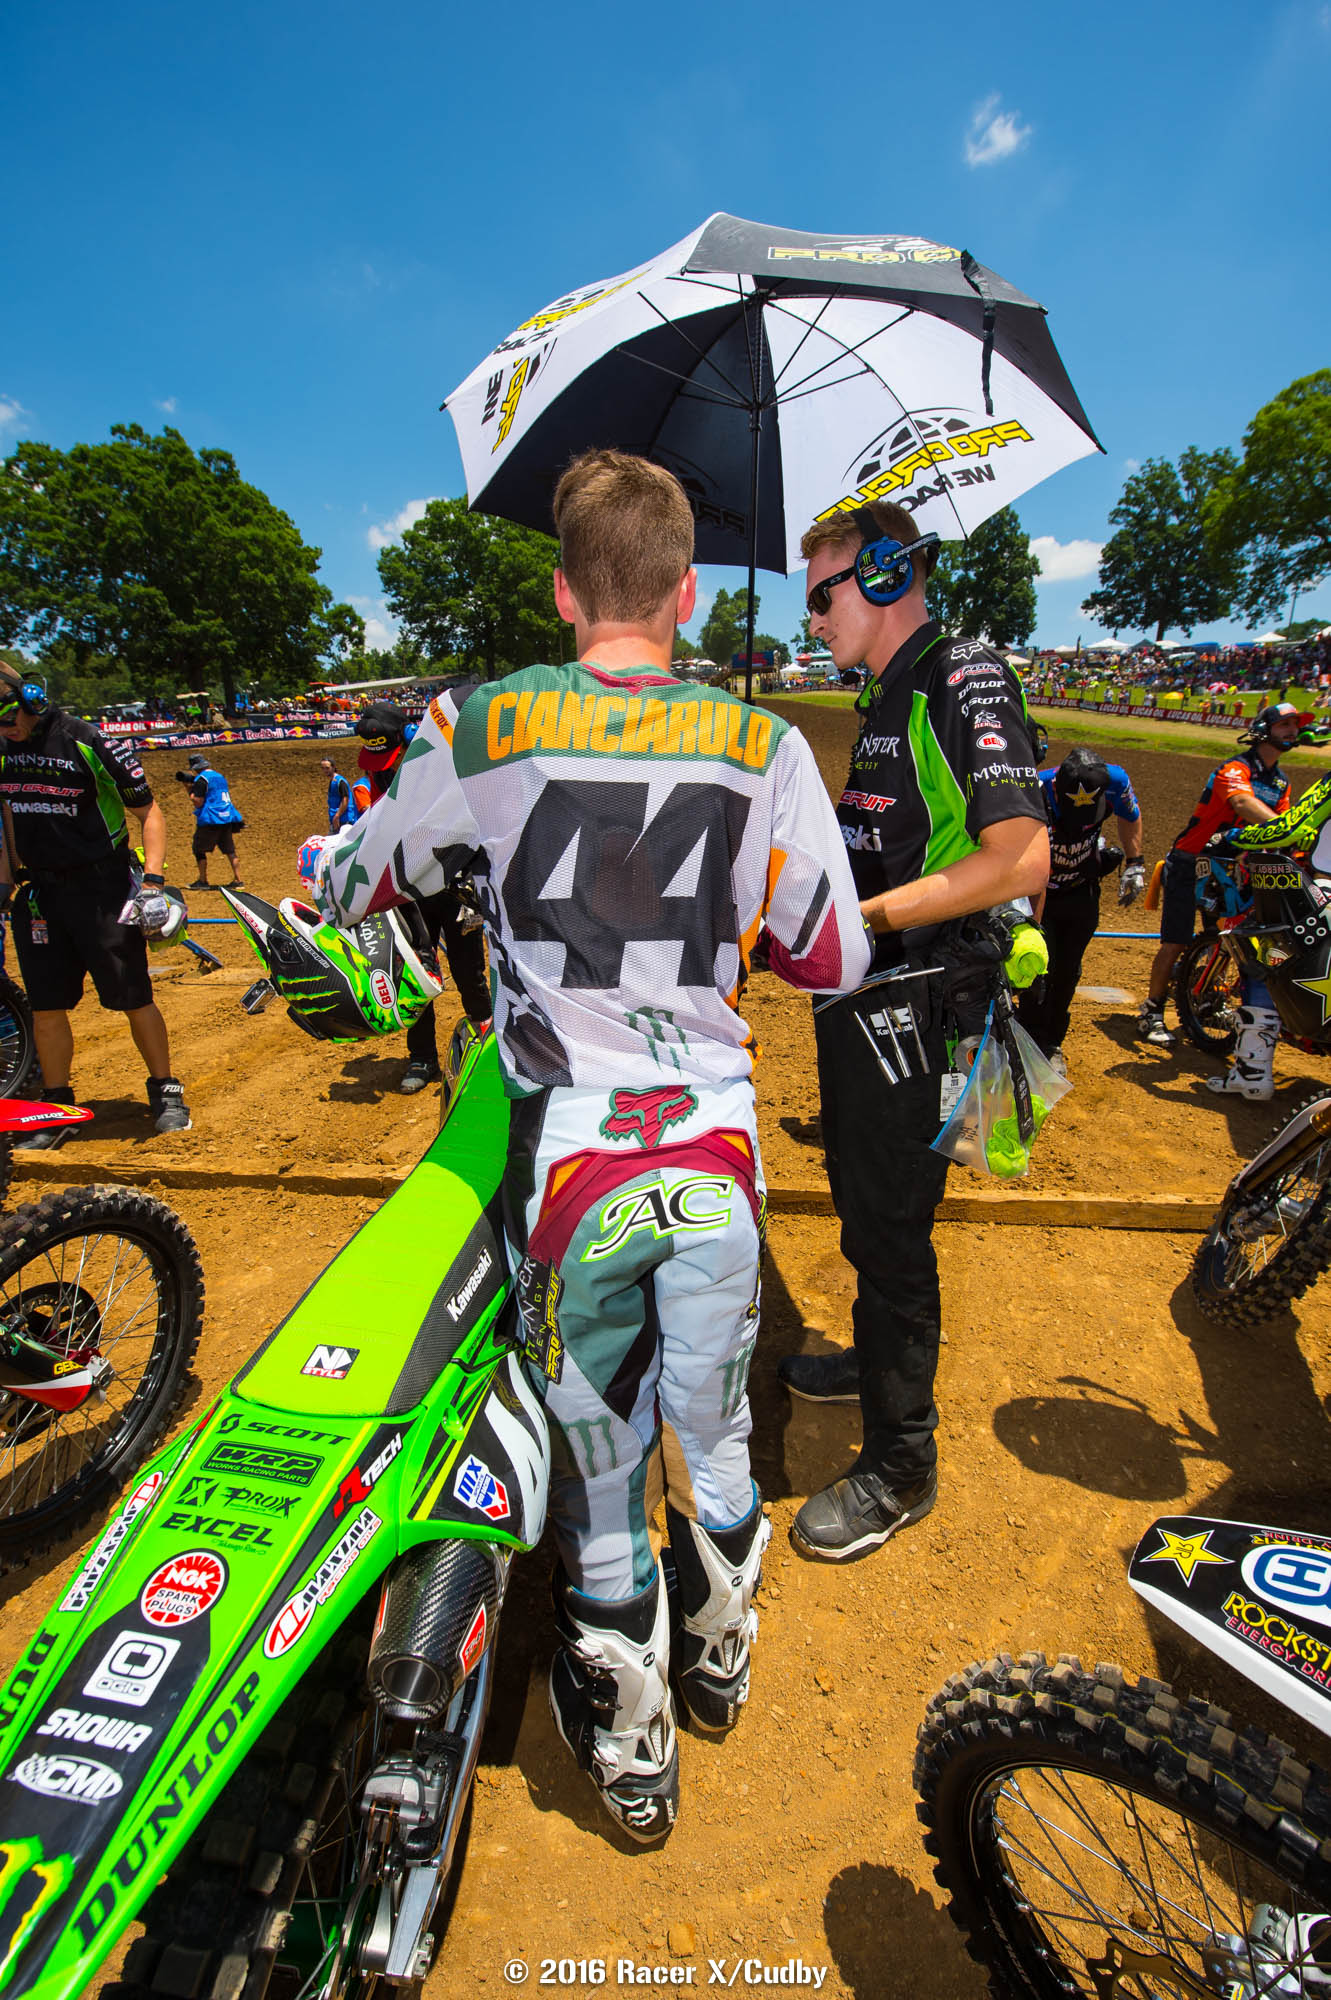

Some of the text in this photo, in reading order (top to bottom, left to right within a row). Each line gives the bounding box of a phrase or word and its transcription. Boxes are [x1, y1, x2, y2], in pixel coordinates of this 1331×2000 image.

[958, 680, 1006, 700] DUNLOP
[1099, 704, 1118, 713] LUCAS
[1118, 705, 1130, 714] OIL
[1131, 706, 1165, 718] LUCAS OIL
[1166, 710, 1203, 722] LUCAS OIL
[1205, 714, 1245, 727] LUCAS OIL
[486, 690, 774, 769] CIANCIARULO
[22, 783, 85, 797] CIRCUIT
[7, 799, 78, 817] awasaki
[501, 778, 752, 990] 44
[376, 975, 392, 1006] BELL
[20, 1111, 65, 1124] DUNLOP
[587, 1178, 732, 1258] AC
[446, 1247, 493, 1323] Kawasaki
[546, 1334, 561, 1381] PRO
[241, 1421, 352, 1446] SCOTT
[214, 1447, 317, 1471] WRP
[207, 1461, 309, 1484] WORKS RACING PARTS
[457, 1458, 482, 1502] MX
[161, 1512, 274, 1547] EXCEL
[301, 1509, 377, 1611] MAXIMA
[317, 1518, 382, 1605] RACING OILS
[163, 1567, 215, 1590] NGK
[149, 1599, 194, 1616] PLUGS
[156, 1588, 200, 1605] SPARK
[1226, 1616, 1297, 1663] ENERGY
[35, 1707, 153, 1753] SHOWA
[73, 1670, 261, 1955] DUNLOP
